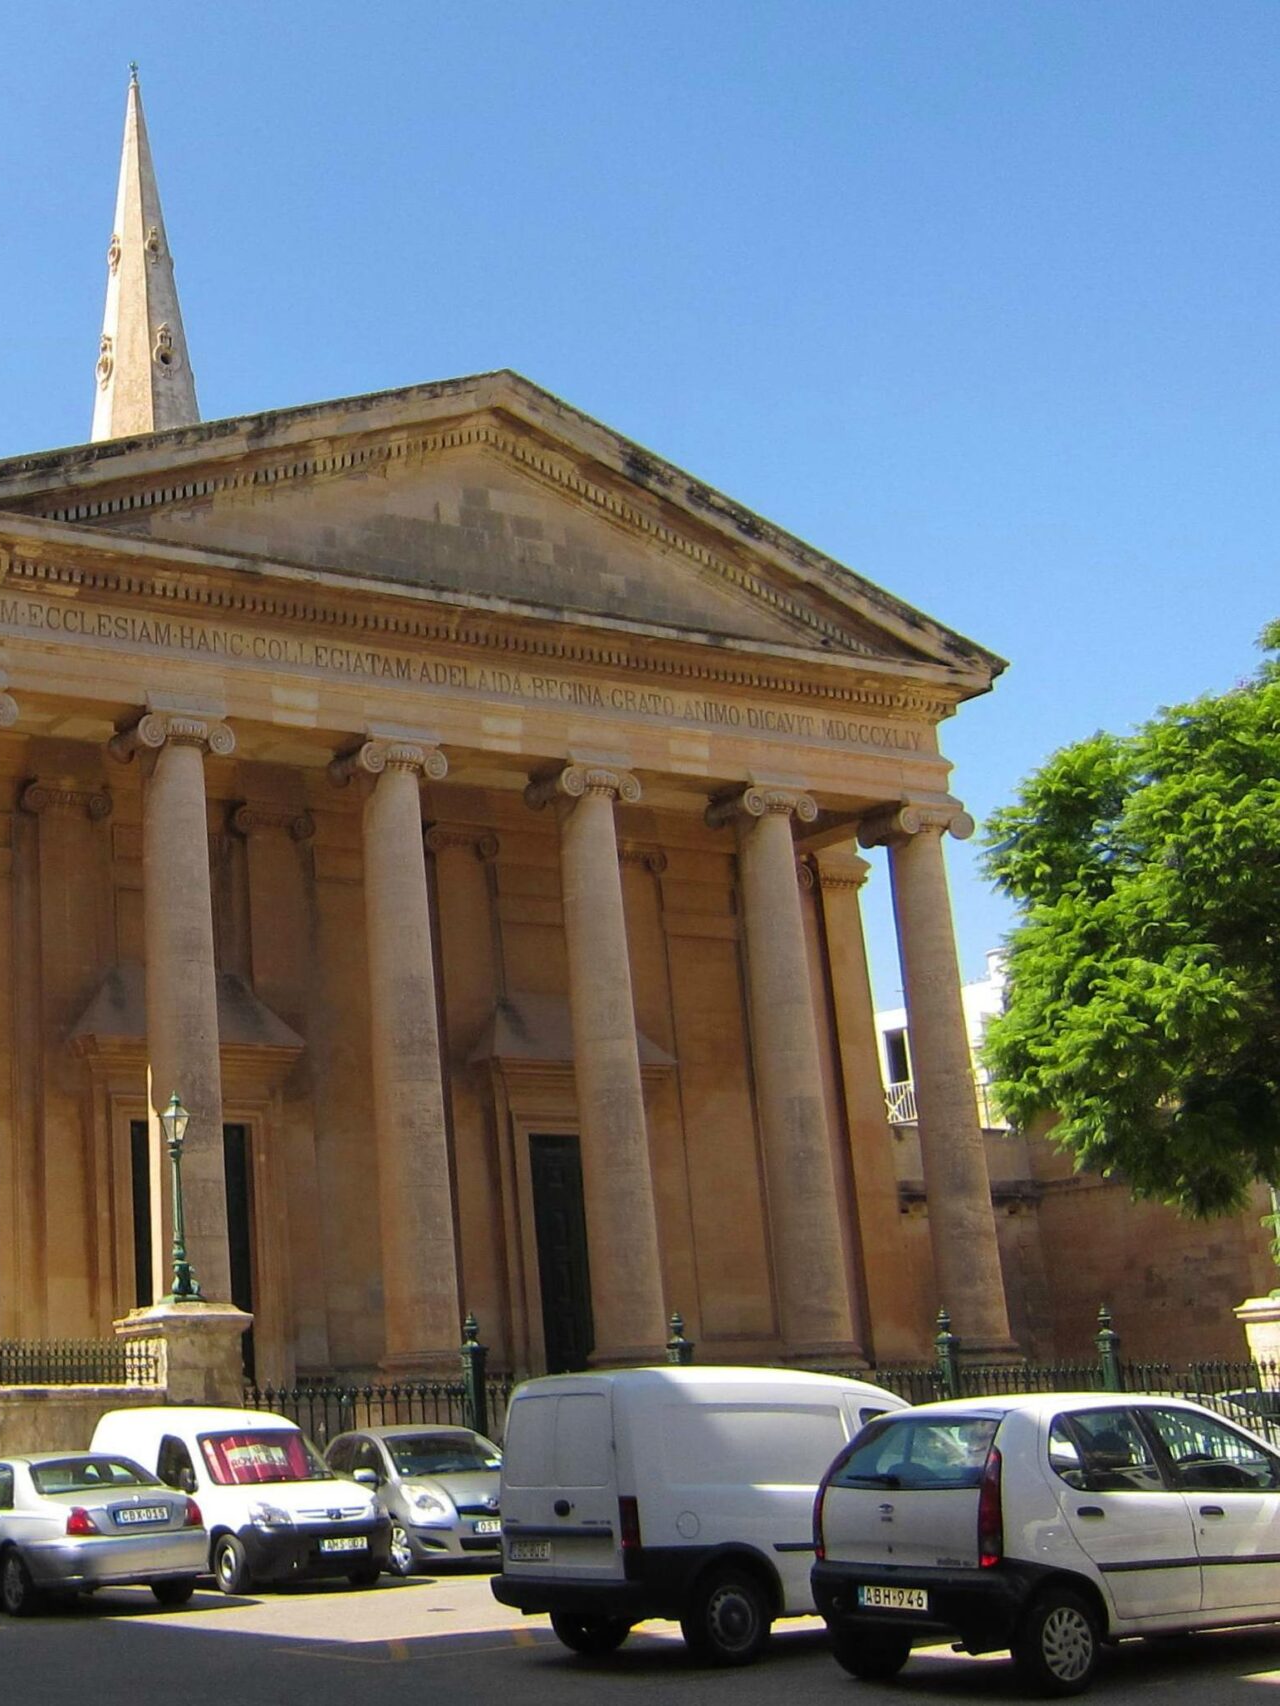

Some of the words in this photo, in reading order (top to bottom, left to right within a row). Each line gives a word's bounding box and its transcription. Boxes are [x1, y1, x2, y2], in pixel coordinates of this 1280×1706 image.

[27, 603, 171, 647] ECCLESIAM
[179, 625, 244, 656] HANC
[252, 637, 412, 680] COLLEGIATAM
[420, 661, 524, 696] ADELAIDA
[532, 677, 604, 707] REGINA
[611, 688, 674, 716] GRATO
[684, 701, 740, 727] ANIMO
[747, 708, 813, 736] DICAVIT
[821, 719, 921, 750] MDCCCXLIV
